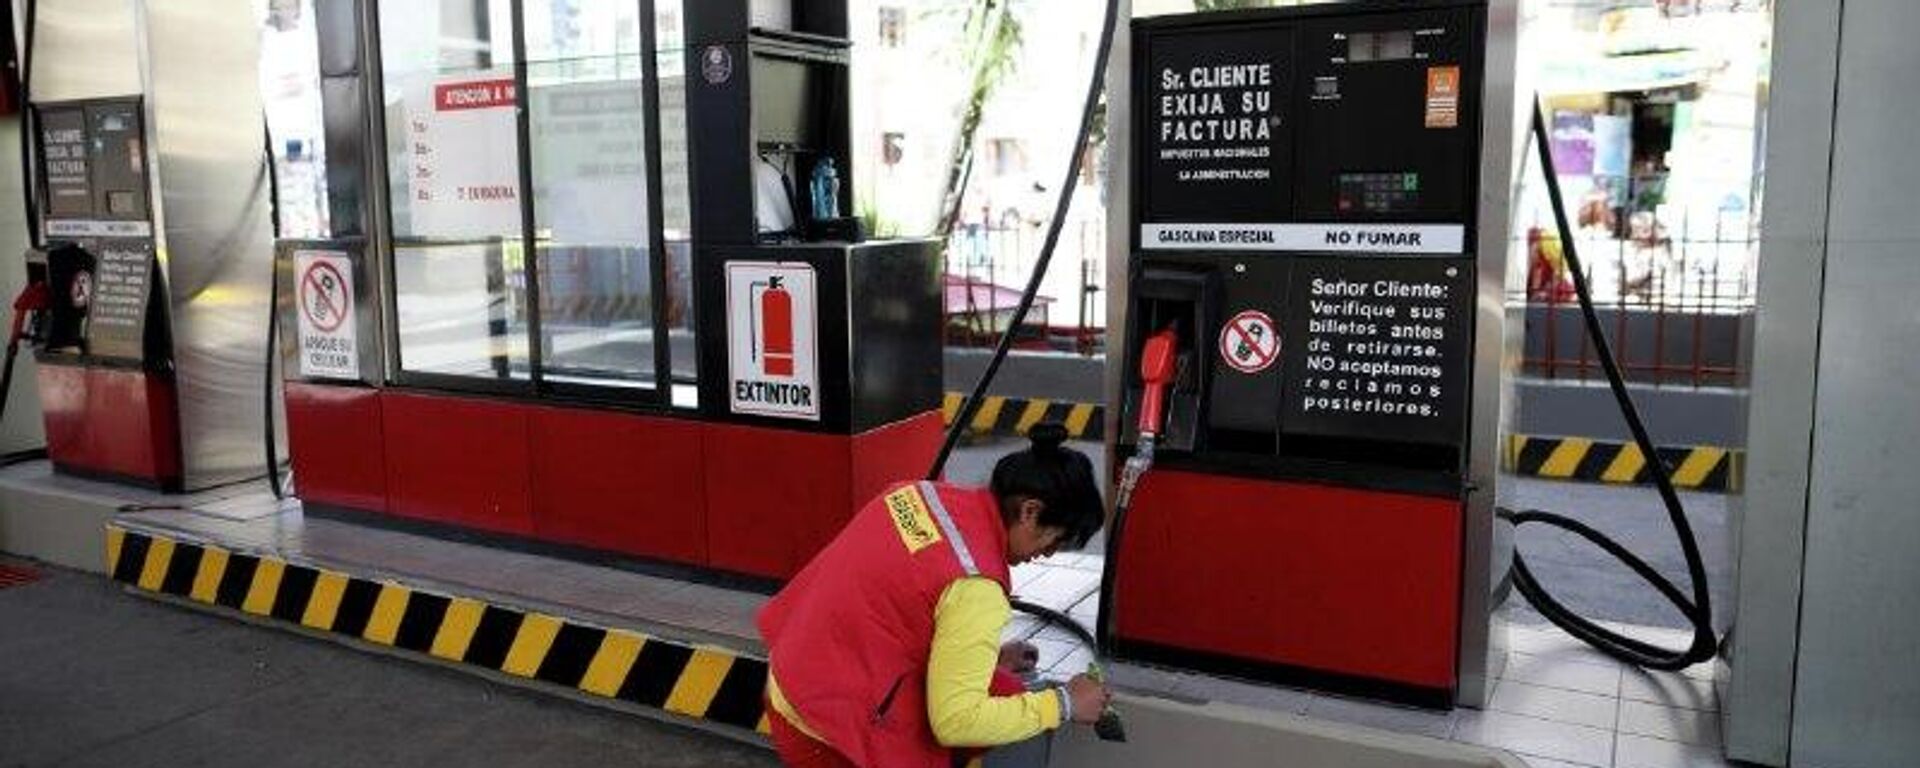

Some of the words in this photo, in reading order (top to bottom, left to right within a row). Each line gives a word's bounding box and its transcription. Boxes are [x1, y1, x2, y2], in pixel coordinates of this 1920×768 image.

[1162, 68, 1184, 90] Sr.
[1190, 64, 1271, 88] CLIENTE
[1162, 93, 1225, 116] EXIJA
[1242, 91, 1270, 113] SU
[1162, 117, 1270, 141] FACTURA
[1158, 230, 1216, 244] GASOLINA
[1218, 230, 1275, 244] ESPECIAL
[1325, 231, 1350, 244] NO
[1357, 231, 1421, 246] FUMAR
[1311, 277, 1368, 297] Señor
[1374, 280, 1449, 299] Cliente:
[1310, 299, 1395, 319] Verifique
[1409, 306, 1446, 319] sus
[1309, 319, 1377, 335] billetes
[1391, 324, 1444, 340] antes
[1307, 338, 1331, 352] de
[1347, 341, 1443, 357] retirarse.
[1306, 355, 1336, 372] NO
[1340, 361, 1442, 378] aceptamos
[735, 379, 811, 407] EXTINTOR
[1304, 378, 1441, 397] reclamos
[1304, 397, 1439, 417] posteriores.
